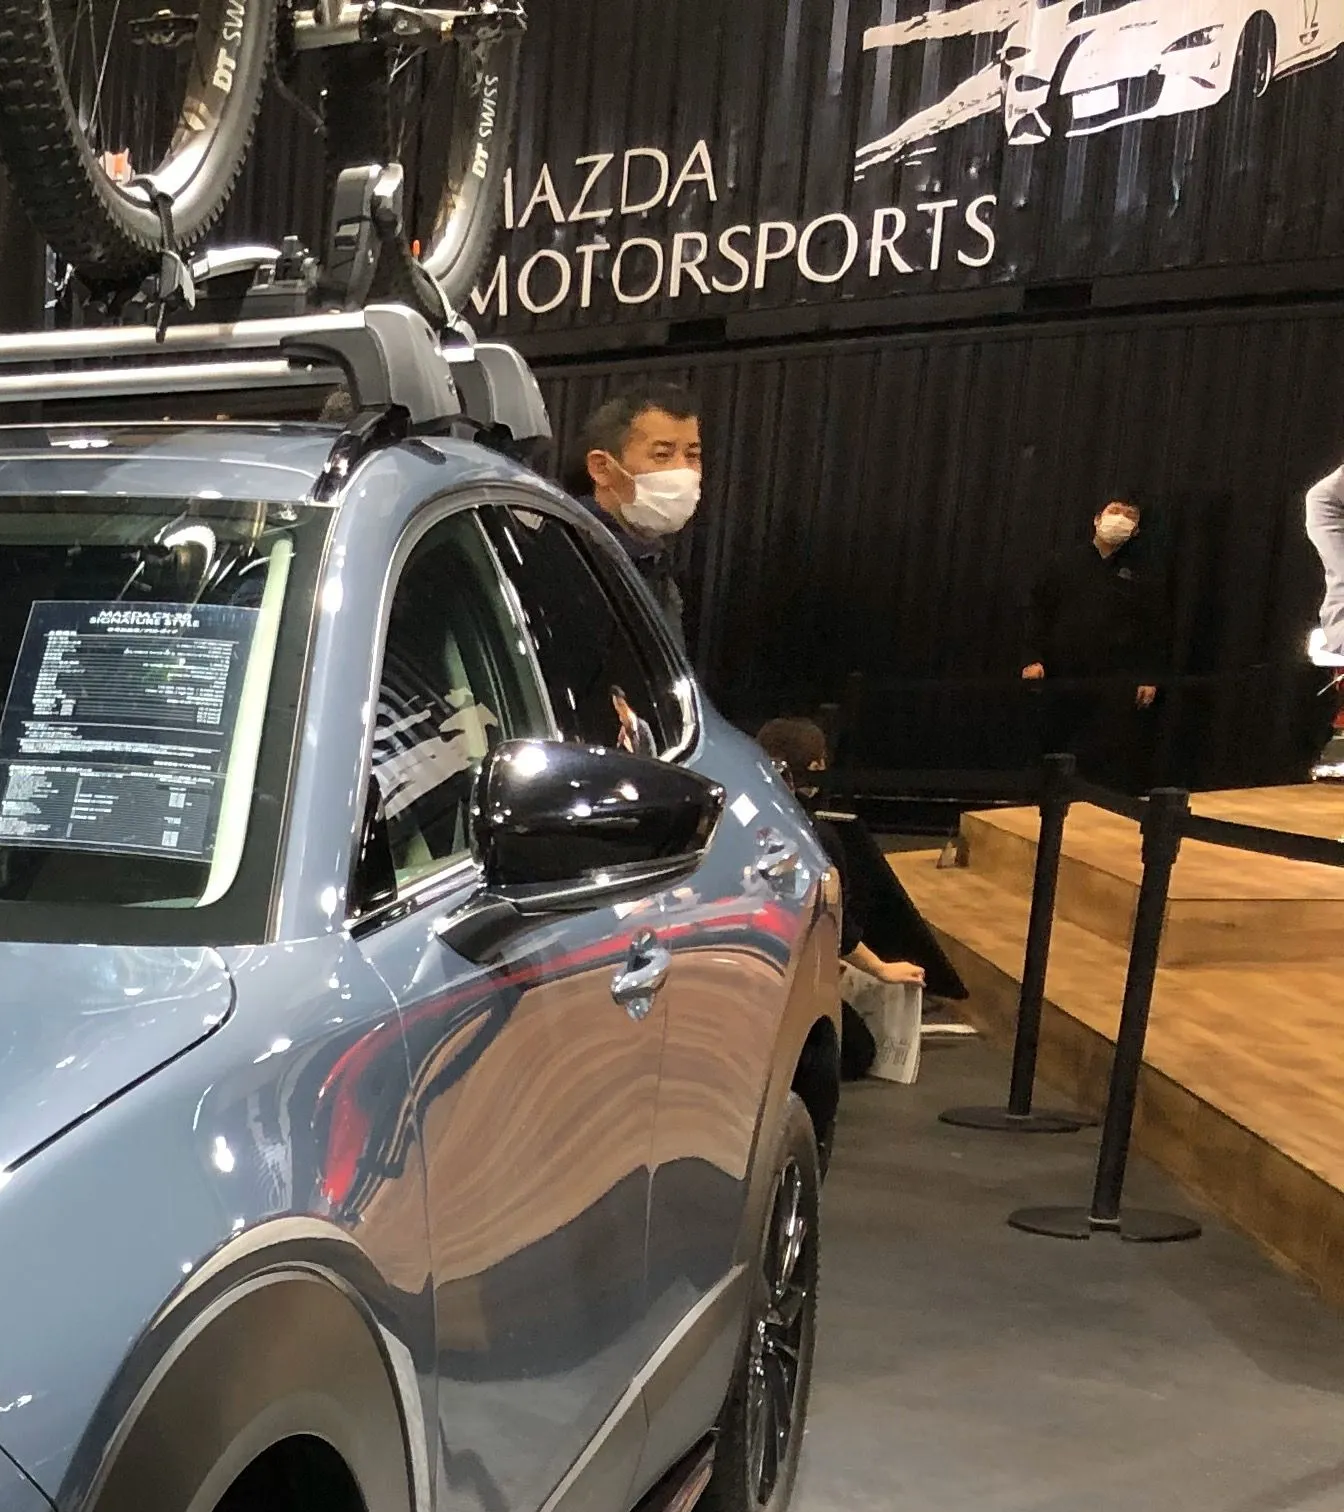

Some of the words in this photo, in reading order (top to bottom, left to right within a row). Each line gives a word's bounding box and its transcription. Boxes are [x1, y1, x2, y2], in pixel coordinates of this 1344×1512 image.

[213, 48, 237, 94] DT
[479, 75, 499, 139] SWISS
[472, 143, 489, 179] DT
[470, 195, 998, 318] MOTORSPORTS
[89, 616, 161, 626] SIGNATURE
[164, 619, 200, 628] STYLE
[99, 610, 150, 619] MAZDA
[152, 612, 192, 621] CX-30
